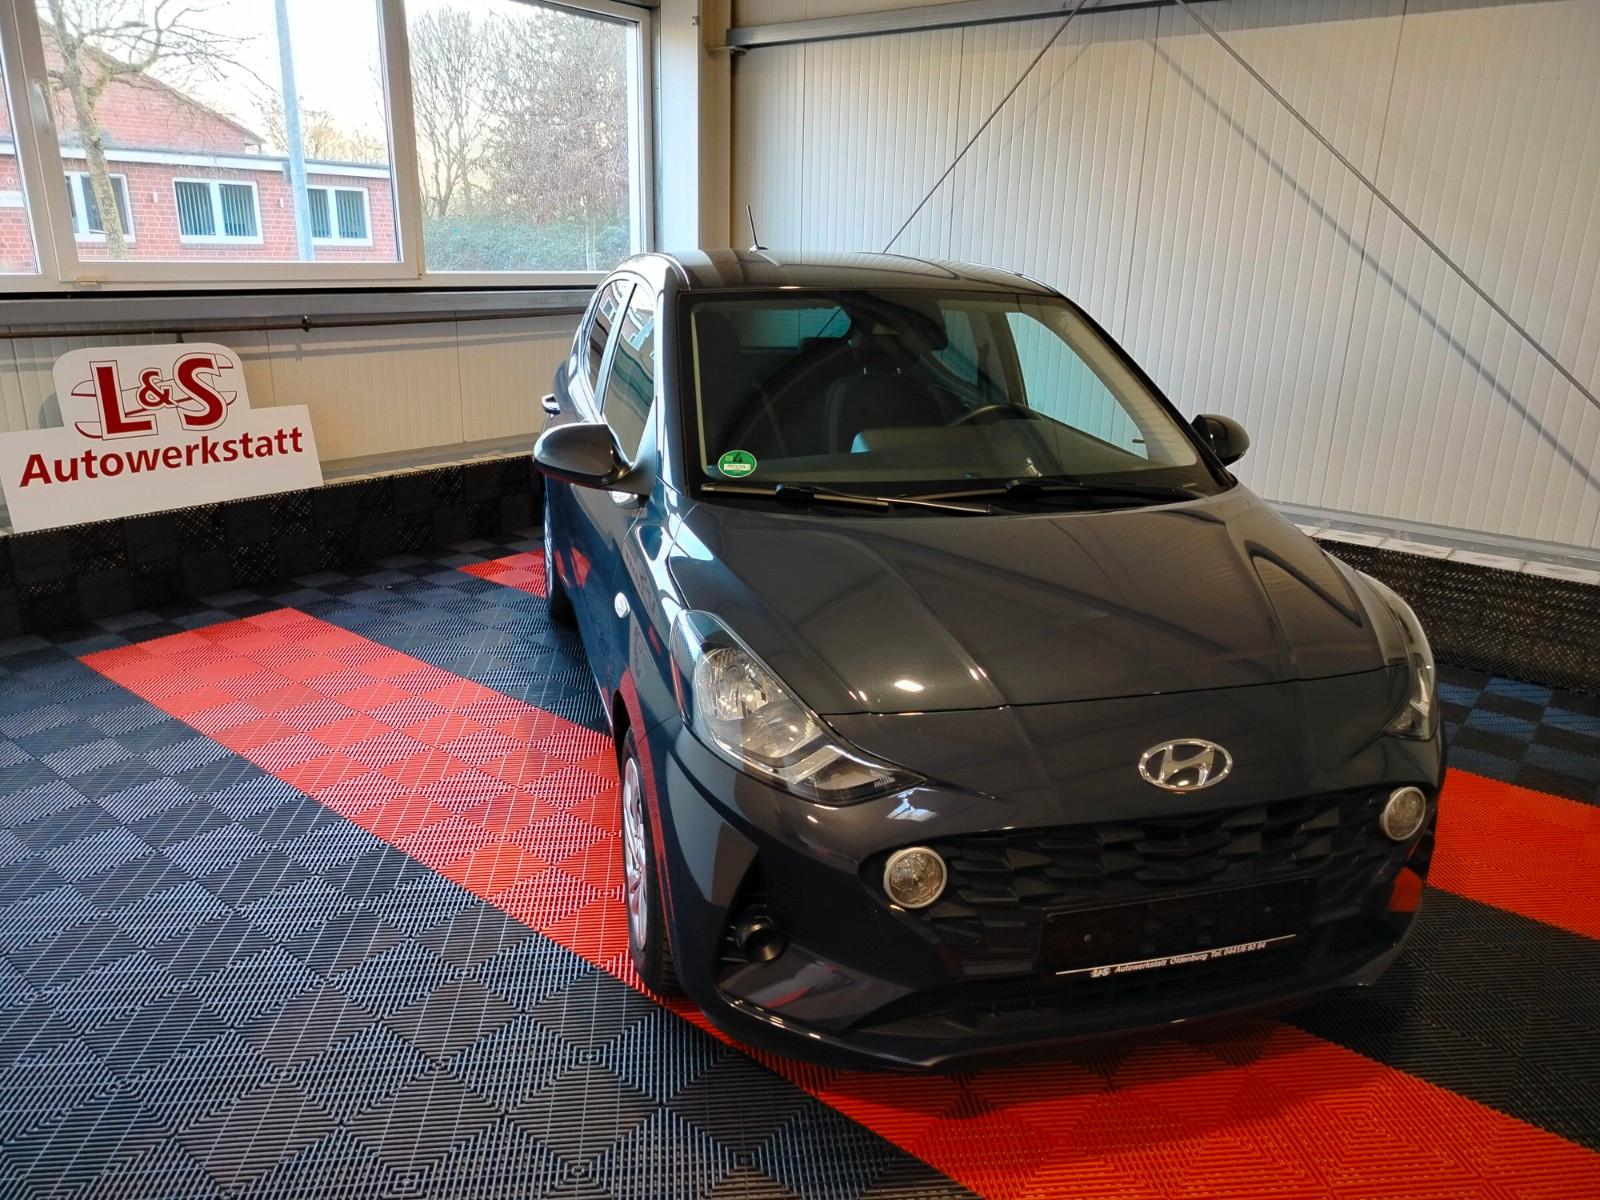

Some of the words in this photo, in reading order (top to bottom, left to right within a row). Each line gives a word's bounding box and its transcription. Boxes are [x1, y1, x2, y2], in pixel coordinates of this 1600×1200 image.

[89, 352, 229, 440] L&S
[20, 427, 303, 488] Autowerkstatt
[1114, 959, 1168, 973] Autowerkstatt
[1169, 952, 1208, 965] Oldenburg
